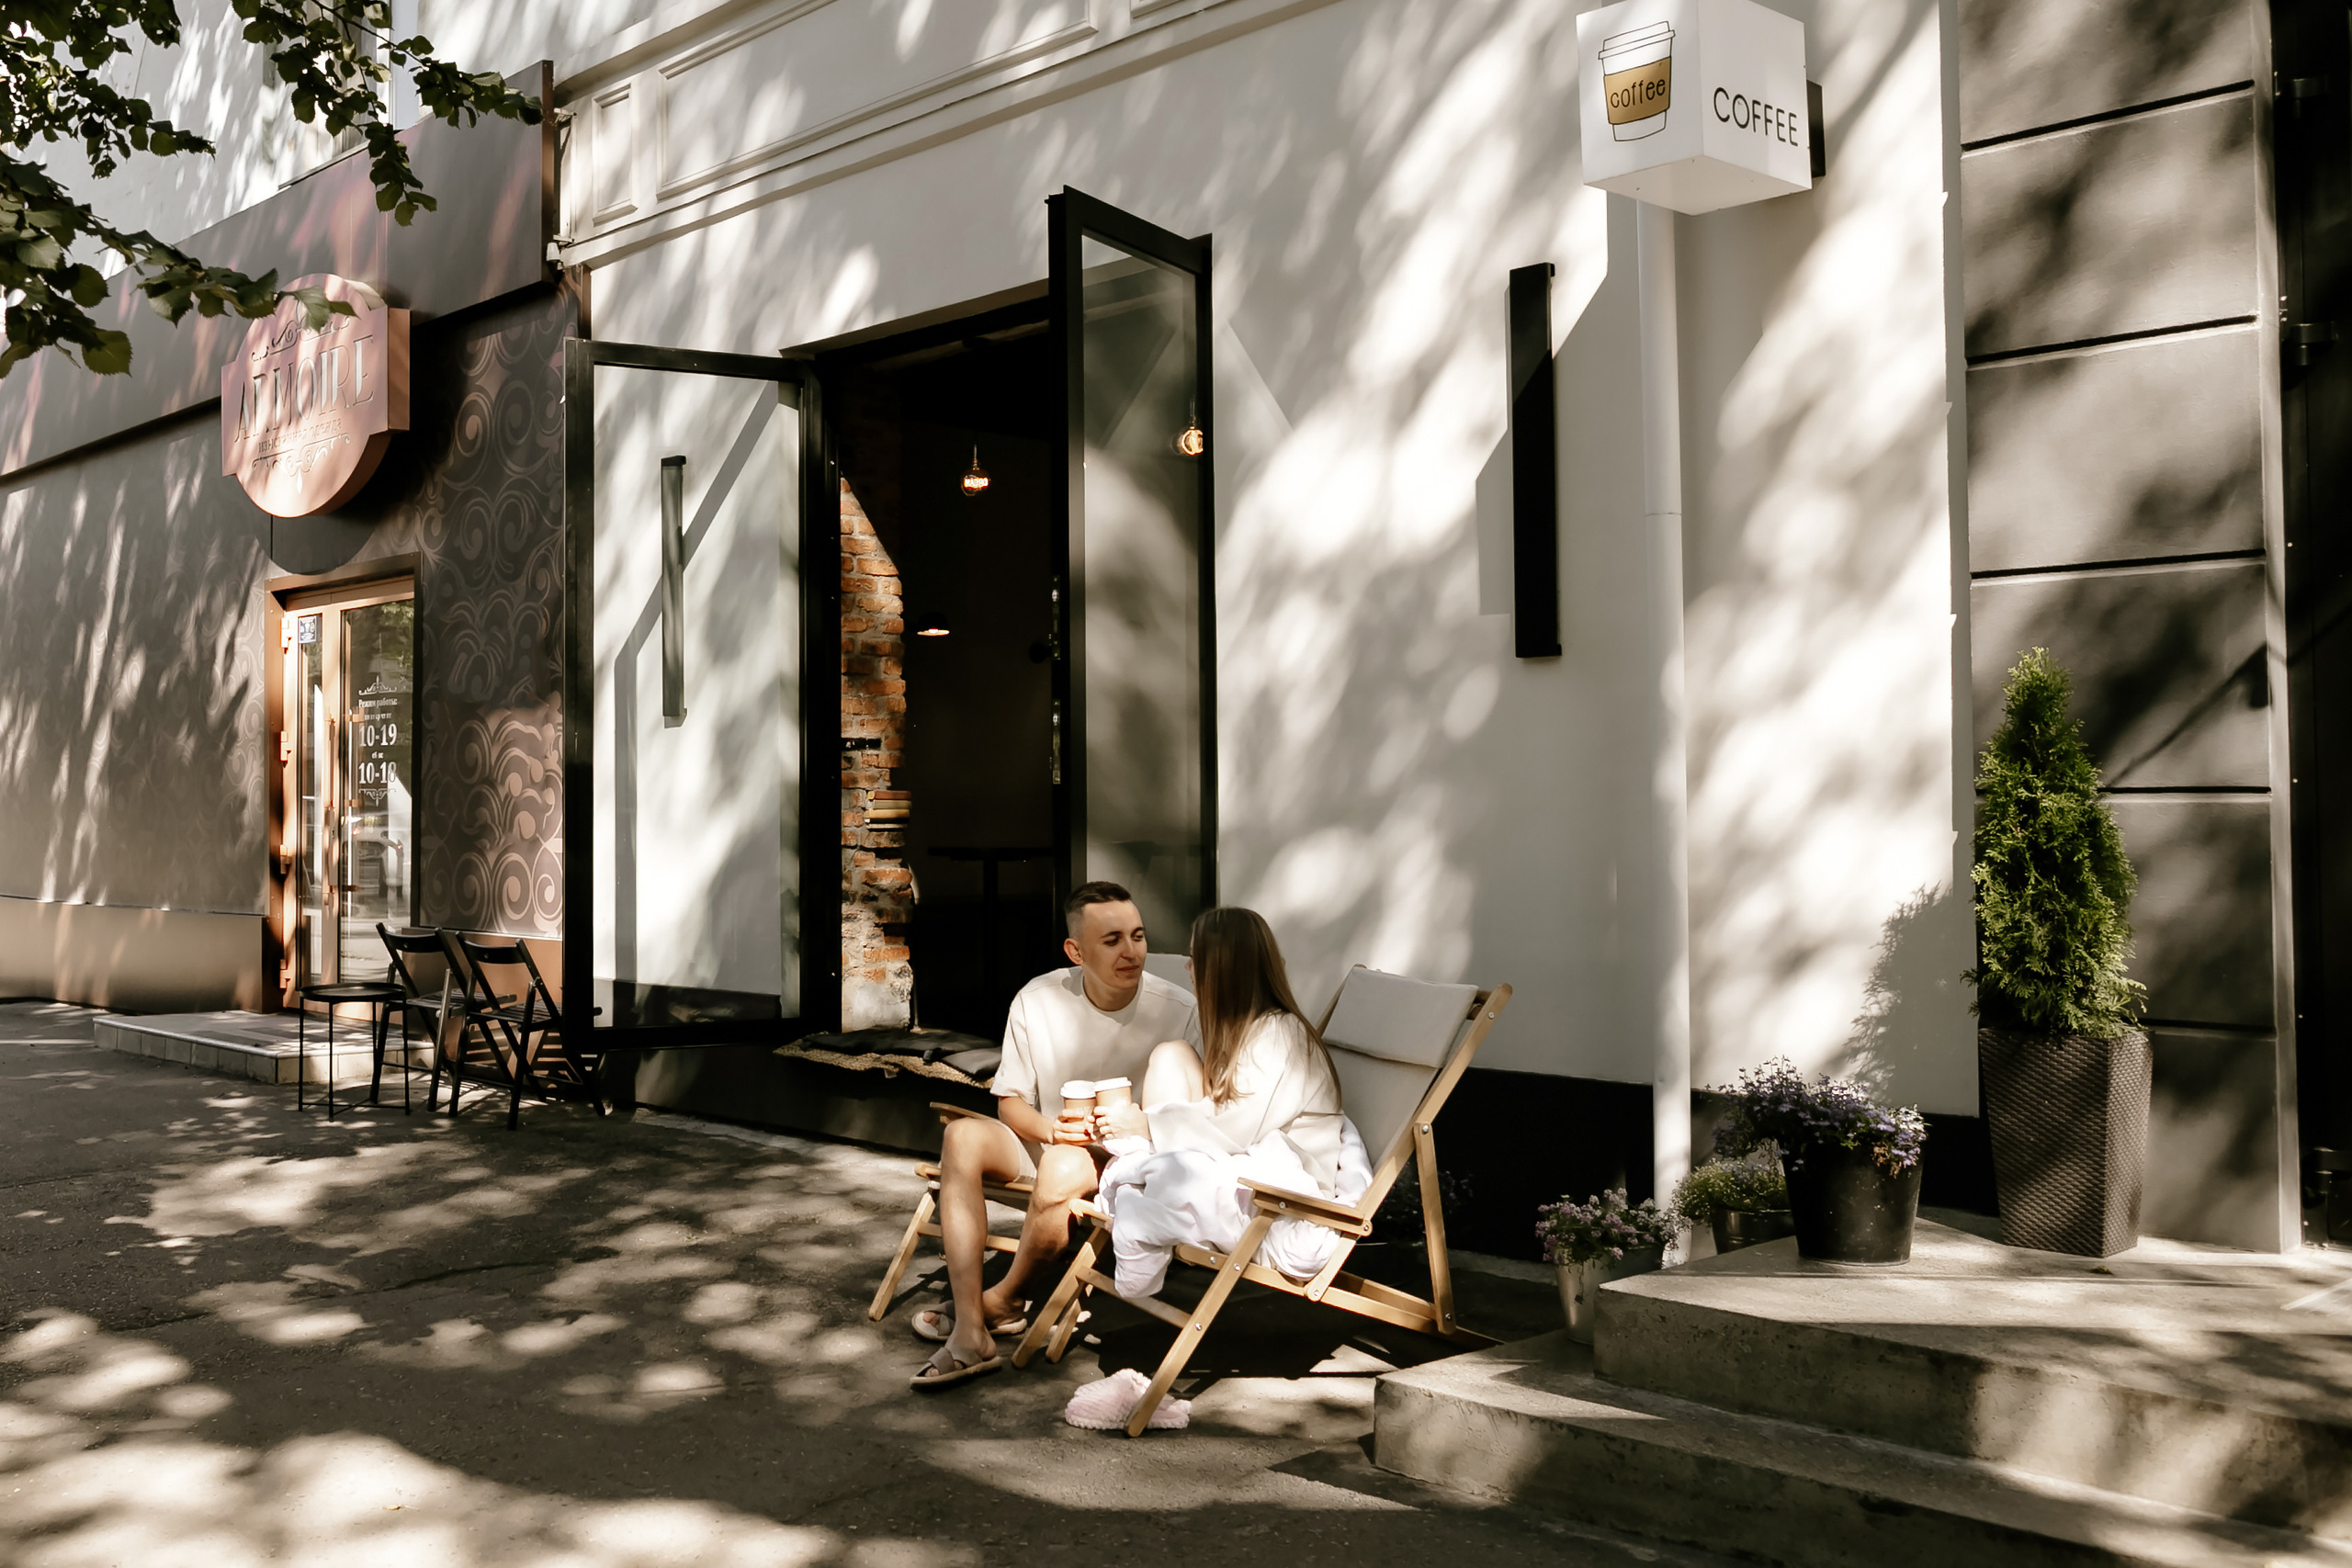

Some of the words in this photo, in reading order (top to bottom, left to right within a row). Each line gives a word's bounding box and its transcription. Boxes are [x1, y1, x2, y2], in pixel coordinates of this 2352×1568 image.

[1610, 78, 1666, 108] coffee
[1713, 86, 1798, 147] COFFEE
[359, 723, 397, 747] 10-19
[358, 761, 397, 784] 10-18
